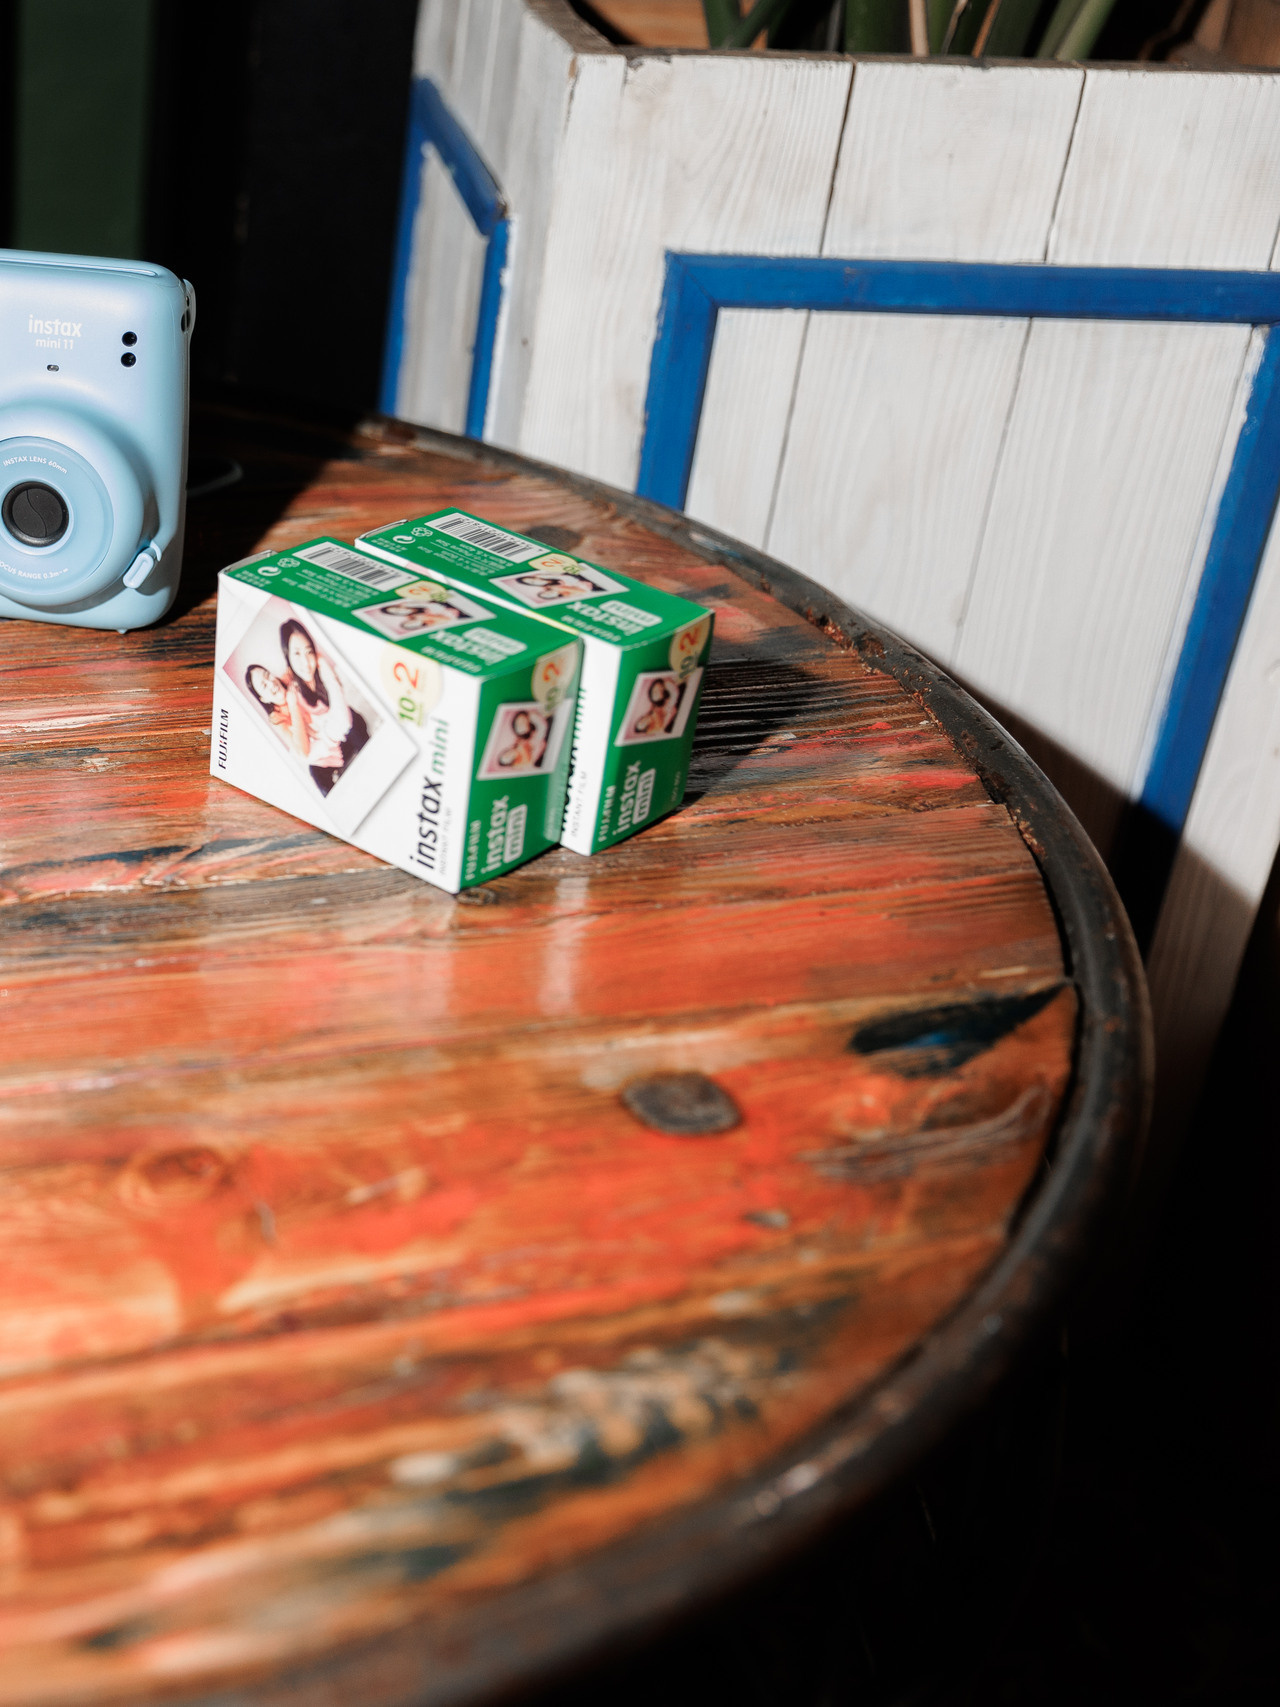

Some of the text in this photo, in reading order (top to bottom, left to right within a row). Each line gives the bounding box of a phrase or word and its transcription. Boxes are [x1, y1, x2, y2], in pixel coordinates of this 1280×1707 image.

[28, 314, 82, 337] instax
[35, 338, 74, 350] mini 11
[2, 456, 68, 474] INSTAX LENS 60mm
[18, 570, 42, 580] RANGE
[566, 601, 645, 636] instax
[393, 661, 419, 722] 10 2
[218, 708, 229, 770] FUJIFILM
[410, 716, 450, 870] instax mini
[612, 760, 642, 835] instax
[481, 795, 510, 876] instax
